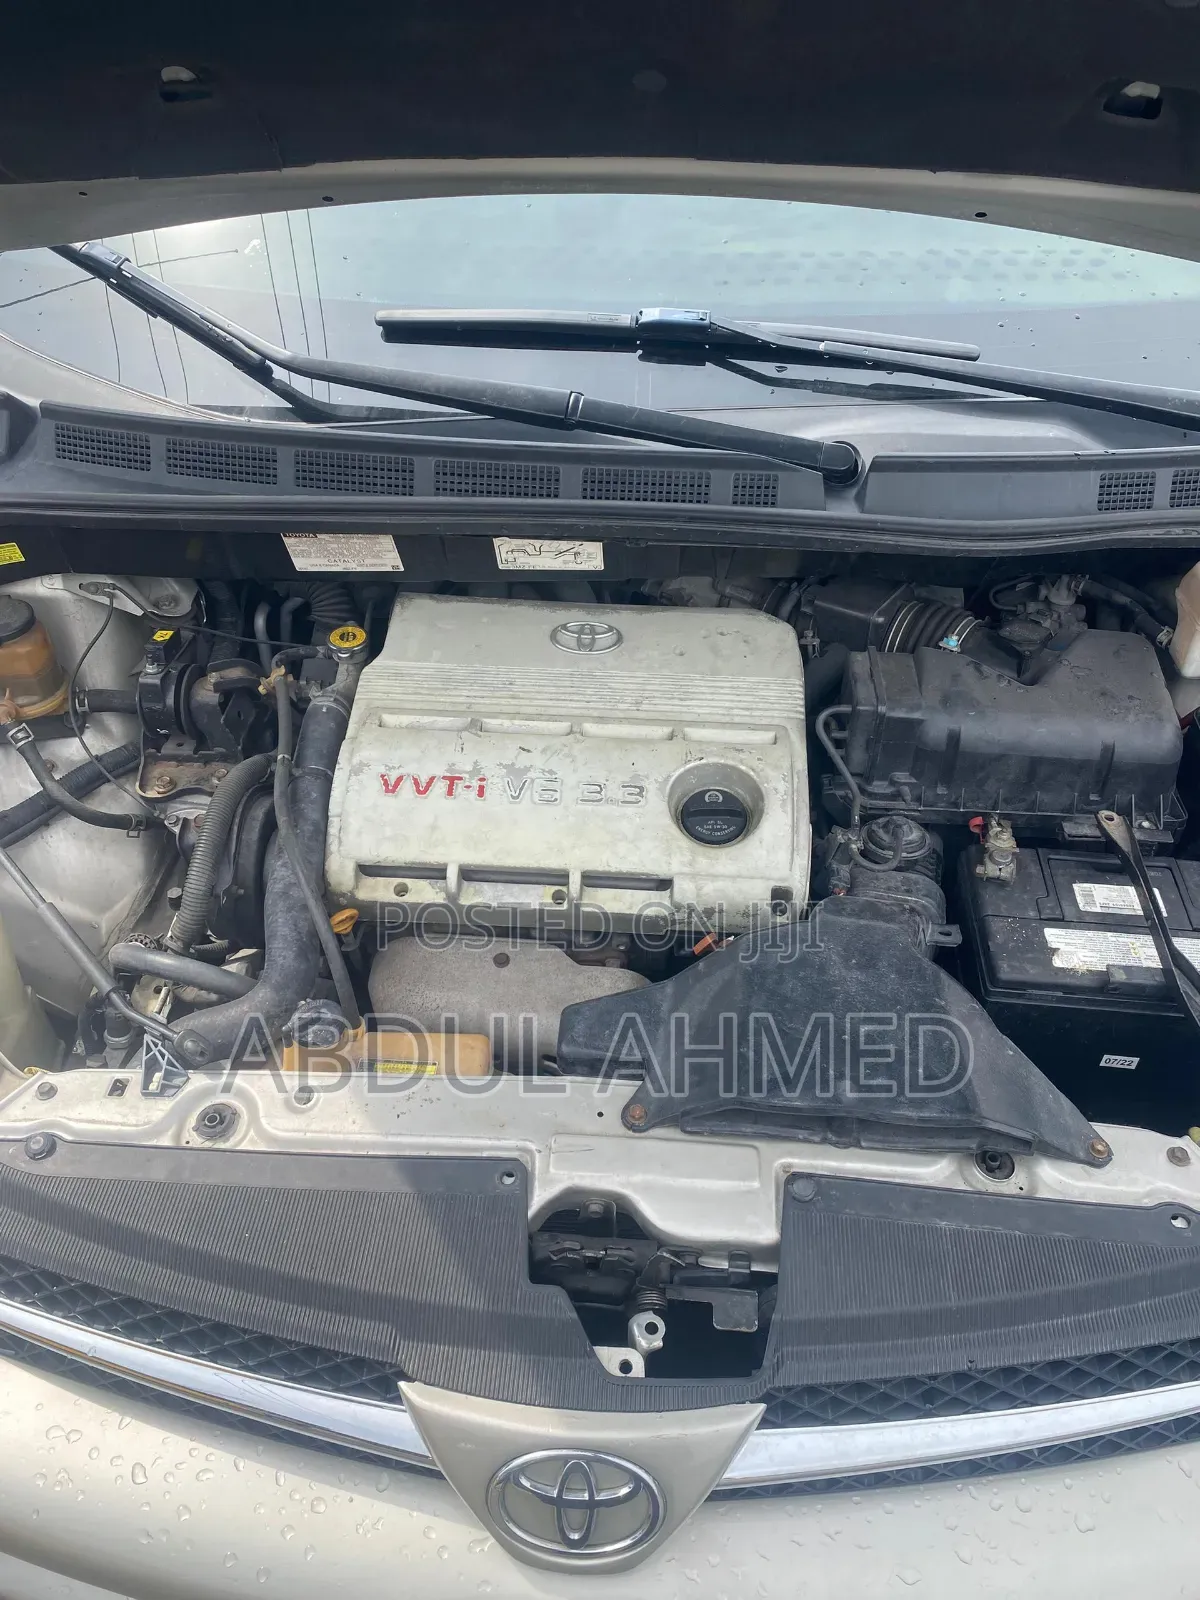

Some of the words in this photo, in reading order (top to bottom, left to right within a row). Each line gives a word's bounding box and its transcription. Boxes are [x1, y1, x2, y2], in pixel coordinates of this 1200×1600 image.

[380, 772, 486, 799] VVT-i
[504, 775, 561, 805] V6
[577, 780, 646, 807] 3.3
[1104, 1057, 1134, 1067] 07/22
